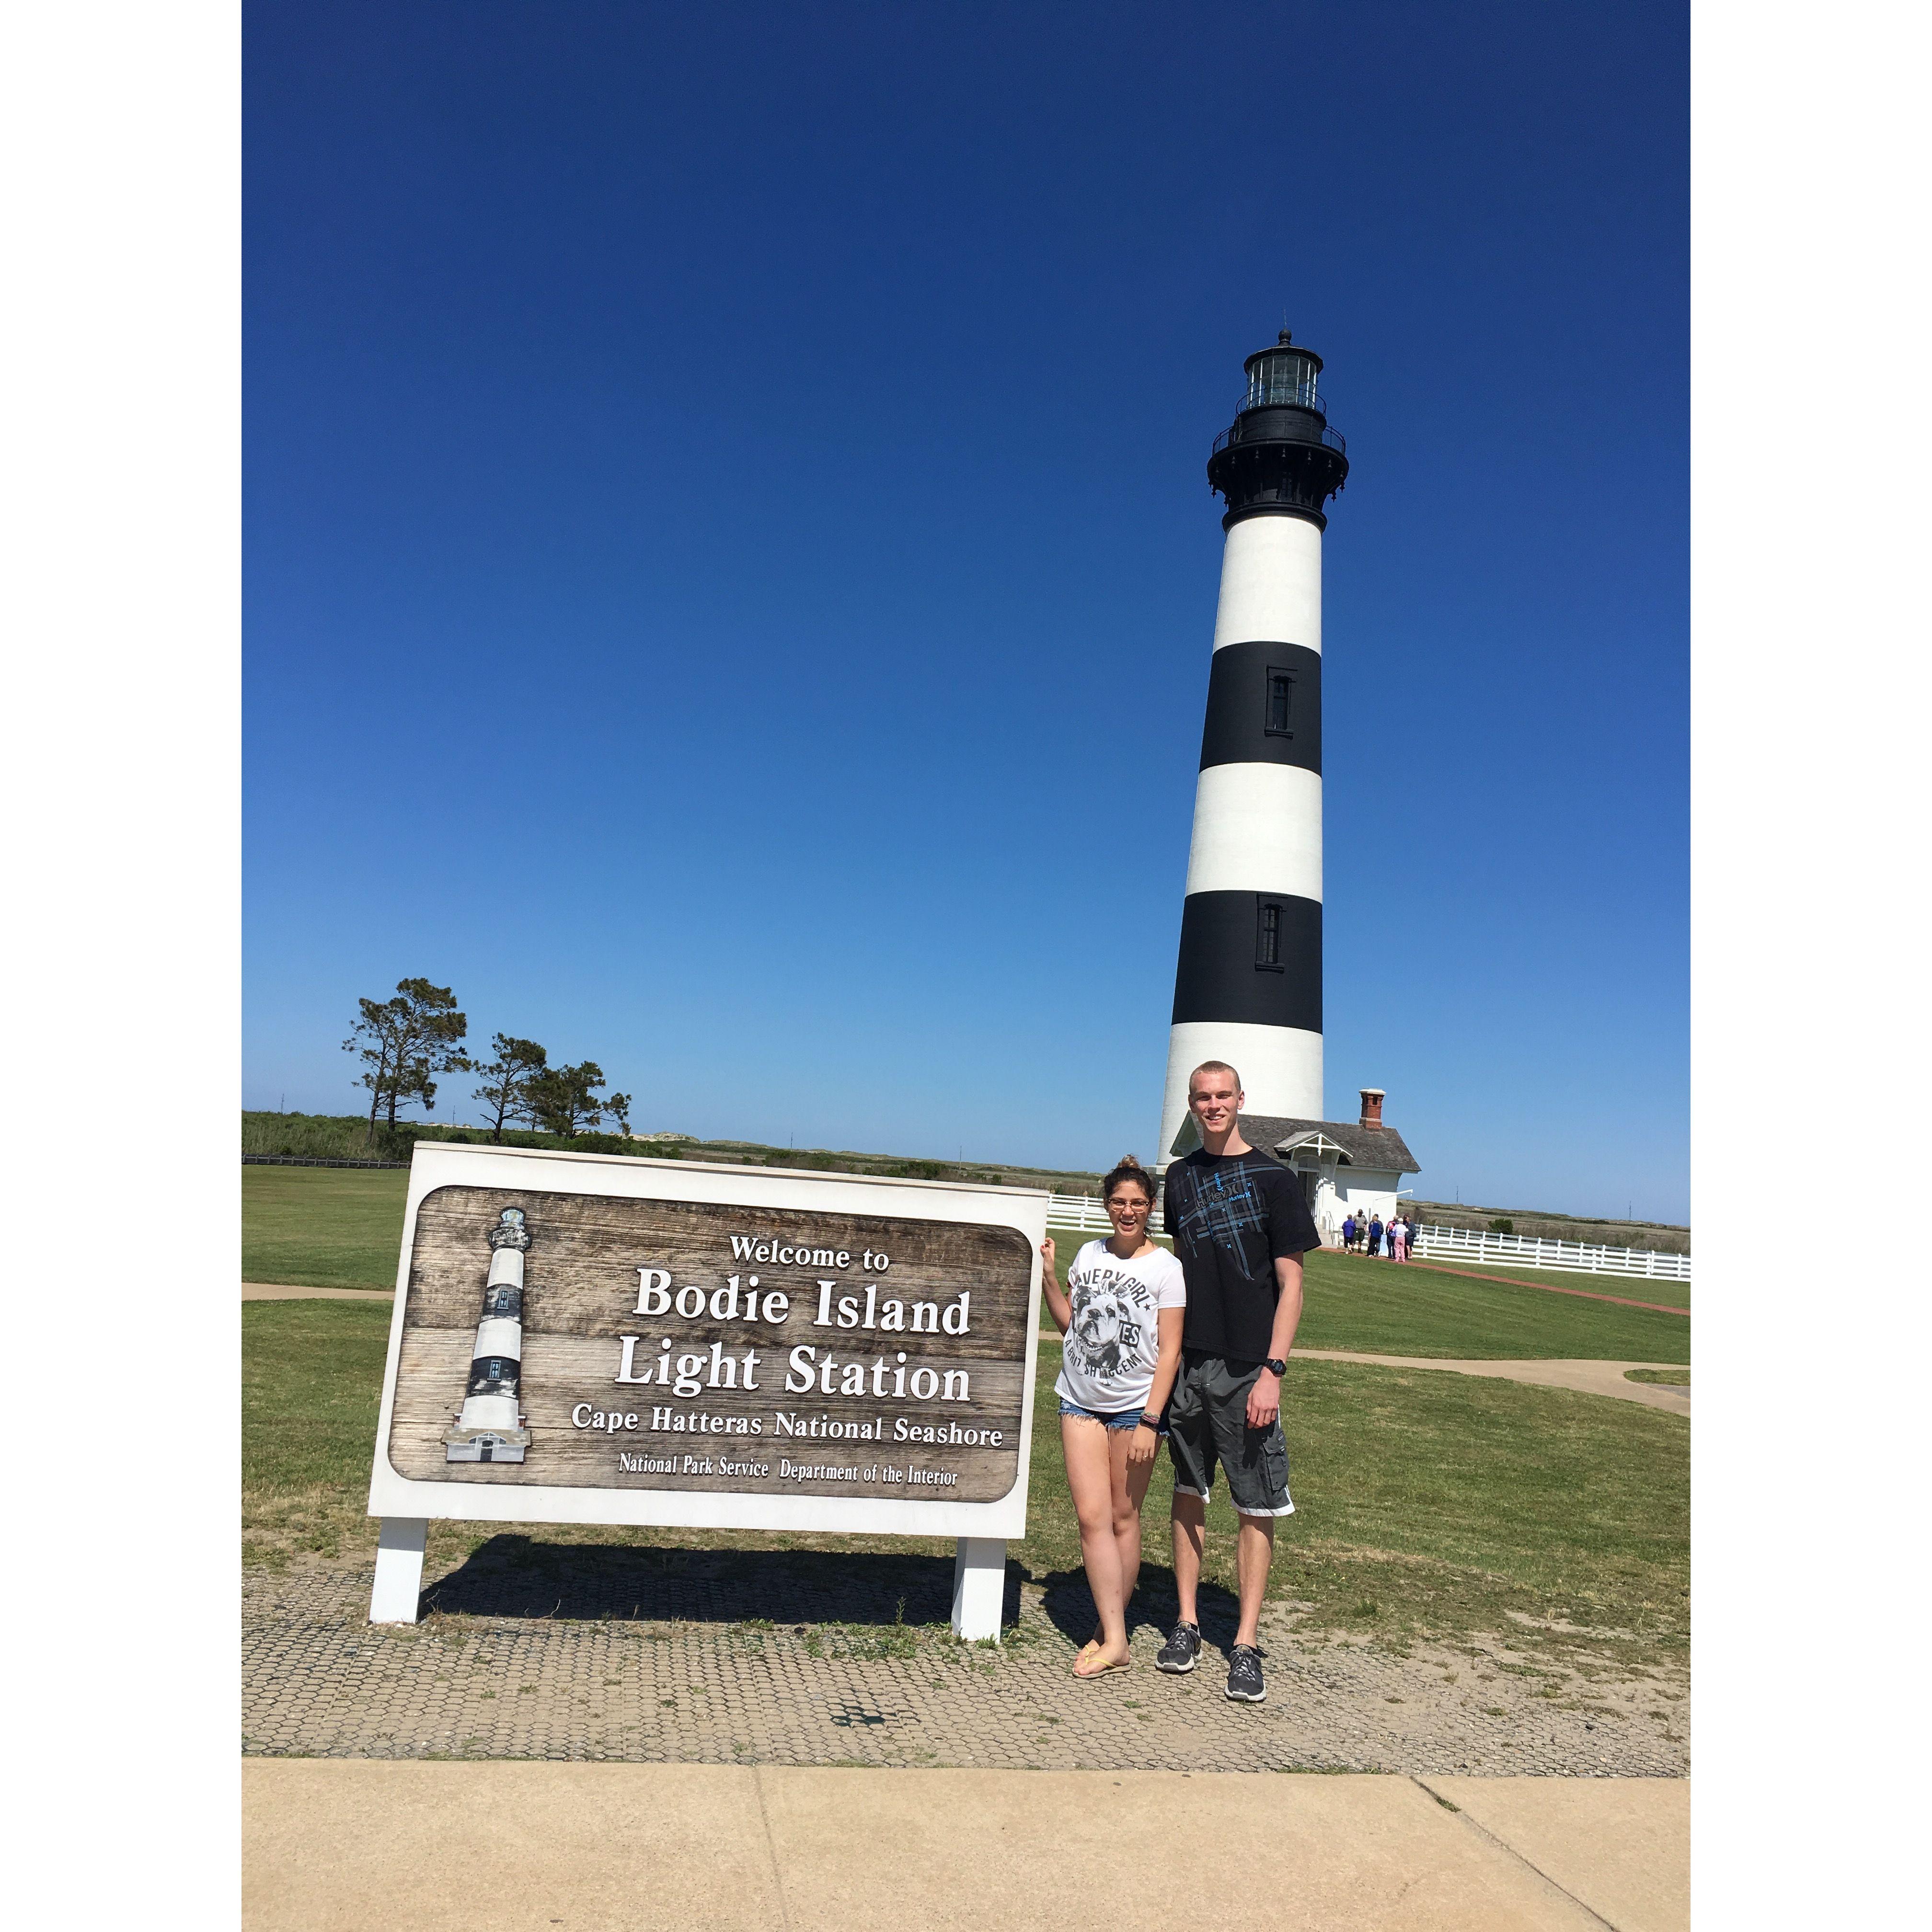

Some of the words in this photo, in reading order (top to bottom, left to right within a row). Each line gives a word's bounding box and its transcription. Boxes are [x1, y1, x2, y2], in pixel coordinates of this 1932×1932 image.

[1196, 1189, 1227, 1208] Hurley
[1228, 1193, 1245, 1202] Hurley
[729, 1235, 850, 1268] Welcome
[862, 1248, 889, 1271] to
[632, 1267, 789, 1326] Bodie
[813, 1280, 971, 1335] Island
[1123, 1276, 1150, 1309] GIRL
[614, 1335, 761, 1398] Light
[784, 1345, 971, 1402] Station
[1067, 1346, 1097, 1378] BRITSH
[1101, 1353, 1142, 1379] CCENT
[572, 1403, 639, 1434] Cape
[650, 1406, 762, 1435] Hatteras
[773, 1412, 882, 1440] National
[893, 1417, 1003, 1447] Seashore
[618, 1452, 678, 1473] National
[682, 1455, 713, 1474] Park
[718, 1456, 769, 1477] Service
[779, 1459, 859, 1483] Department
[863, 1463, 878, 1482] of
[882, 1465, 903, 1483] the
[907, 1465, 958, 1485] Interior
